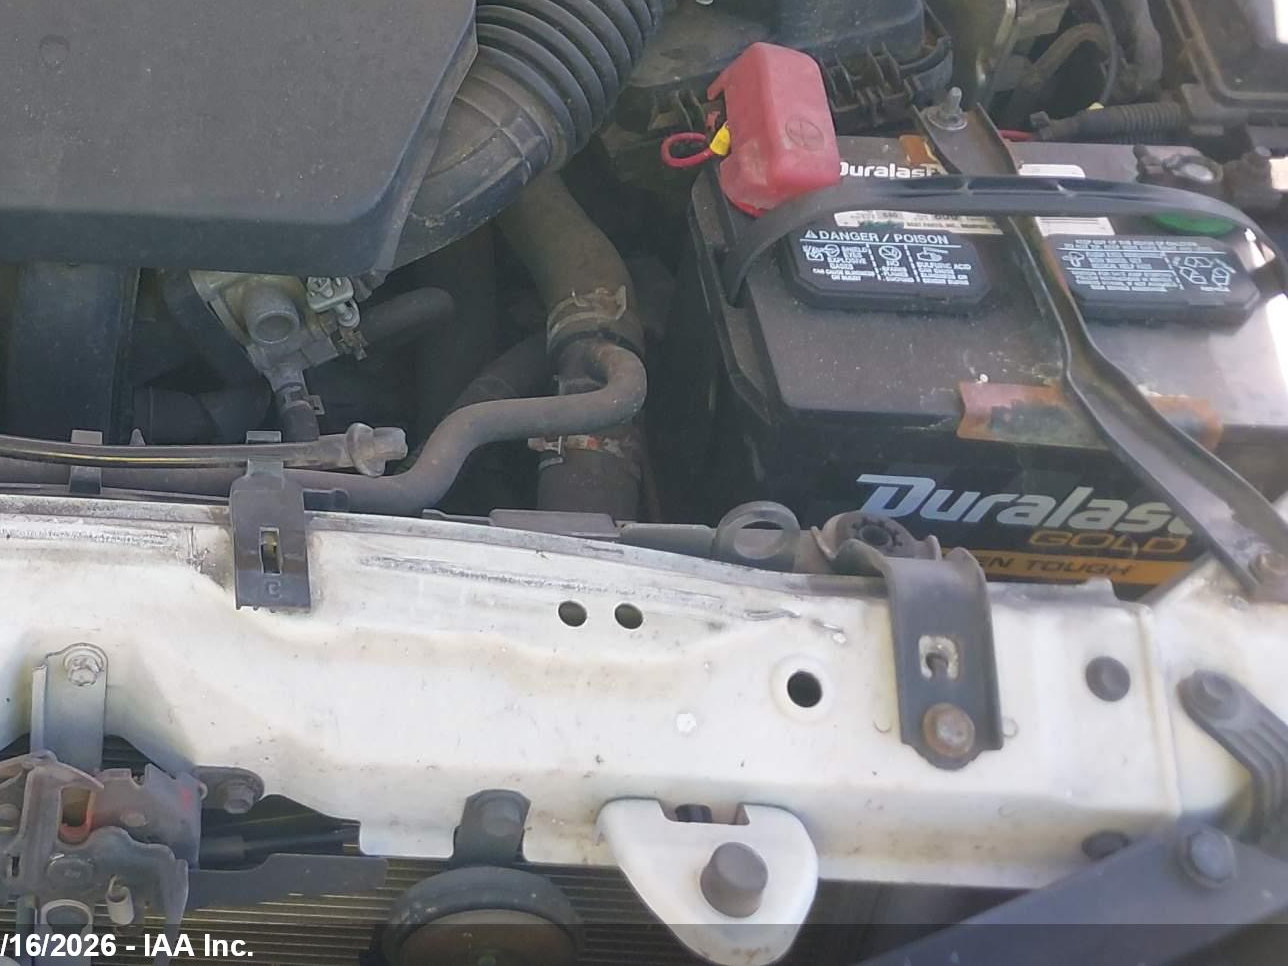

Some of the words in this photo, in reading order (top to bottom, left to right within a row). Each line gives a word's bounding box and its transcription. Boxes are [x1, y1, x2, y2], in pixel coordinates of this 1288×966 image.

[818, 230, 879, 243] DANGER
[894, 234, 949, 245] POISON
[856, 473, 1193, 535] Duralas
[1029, 530, 1188, 554] GOLD
[1026, 559, 1133, 575] TOUGH
